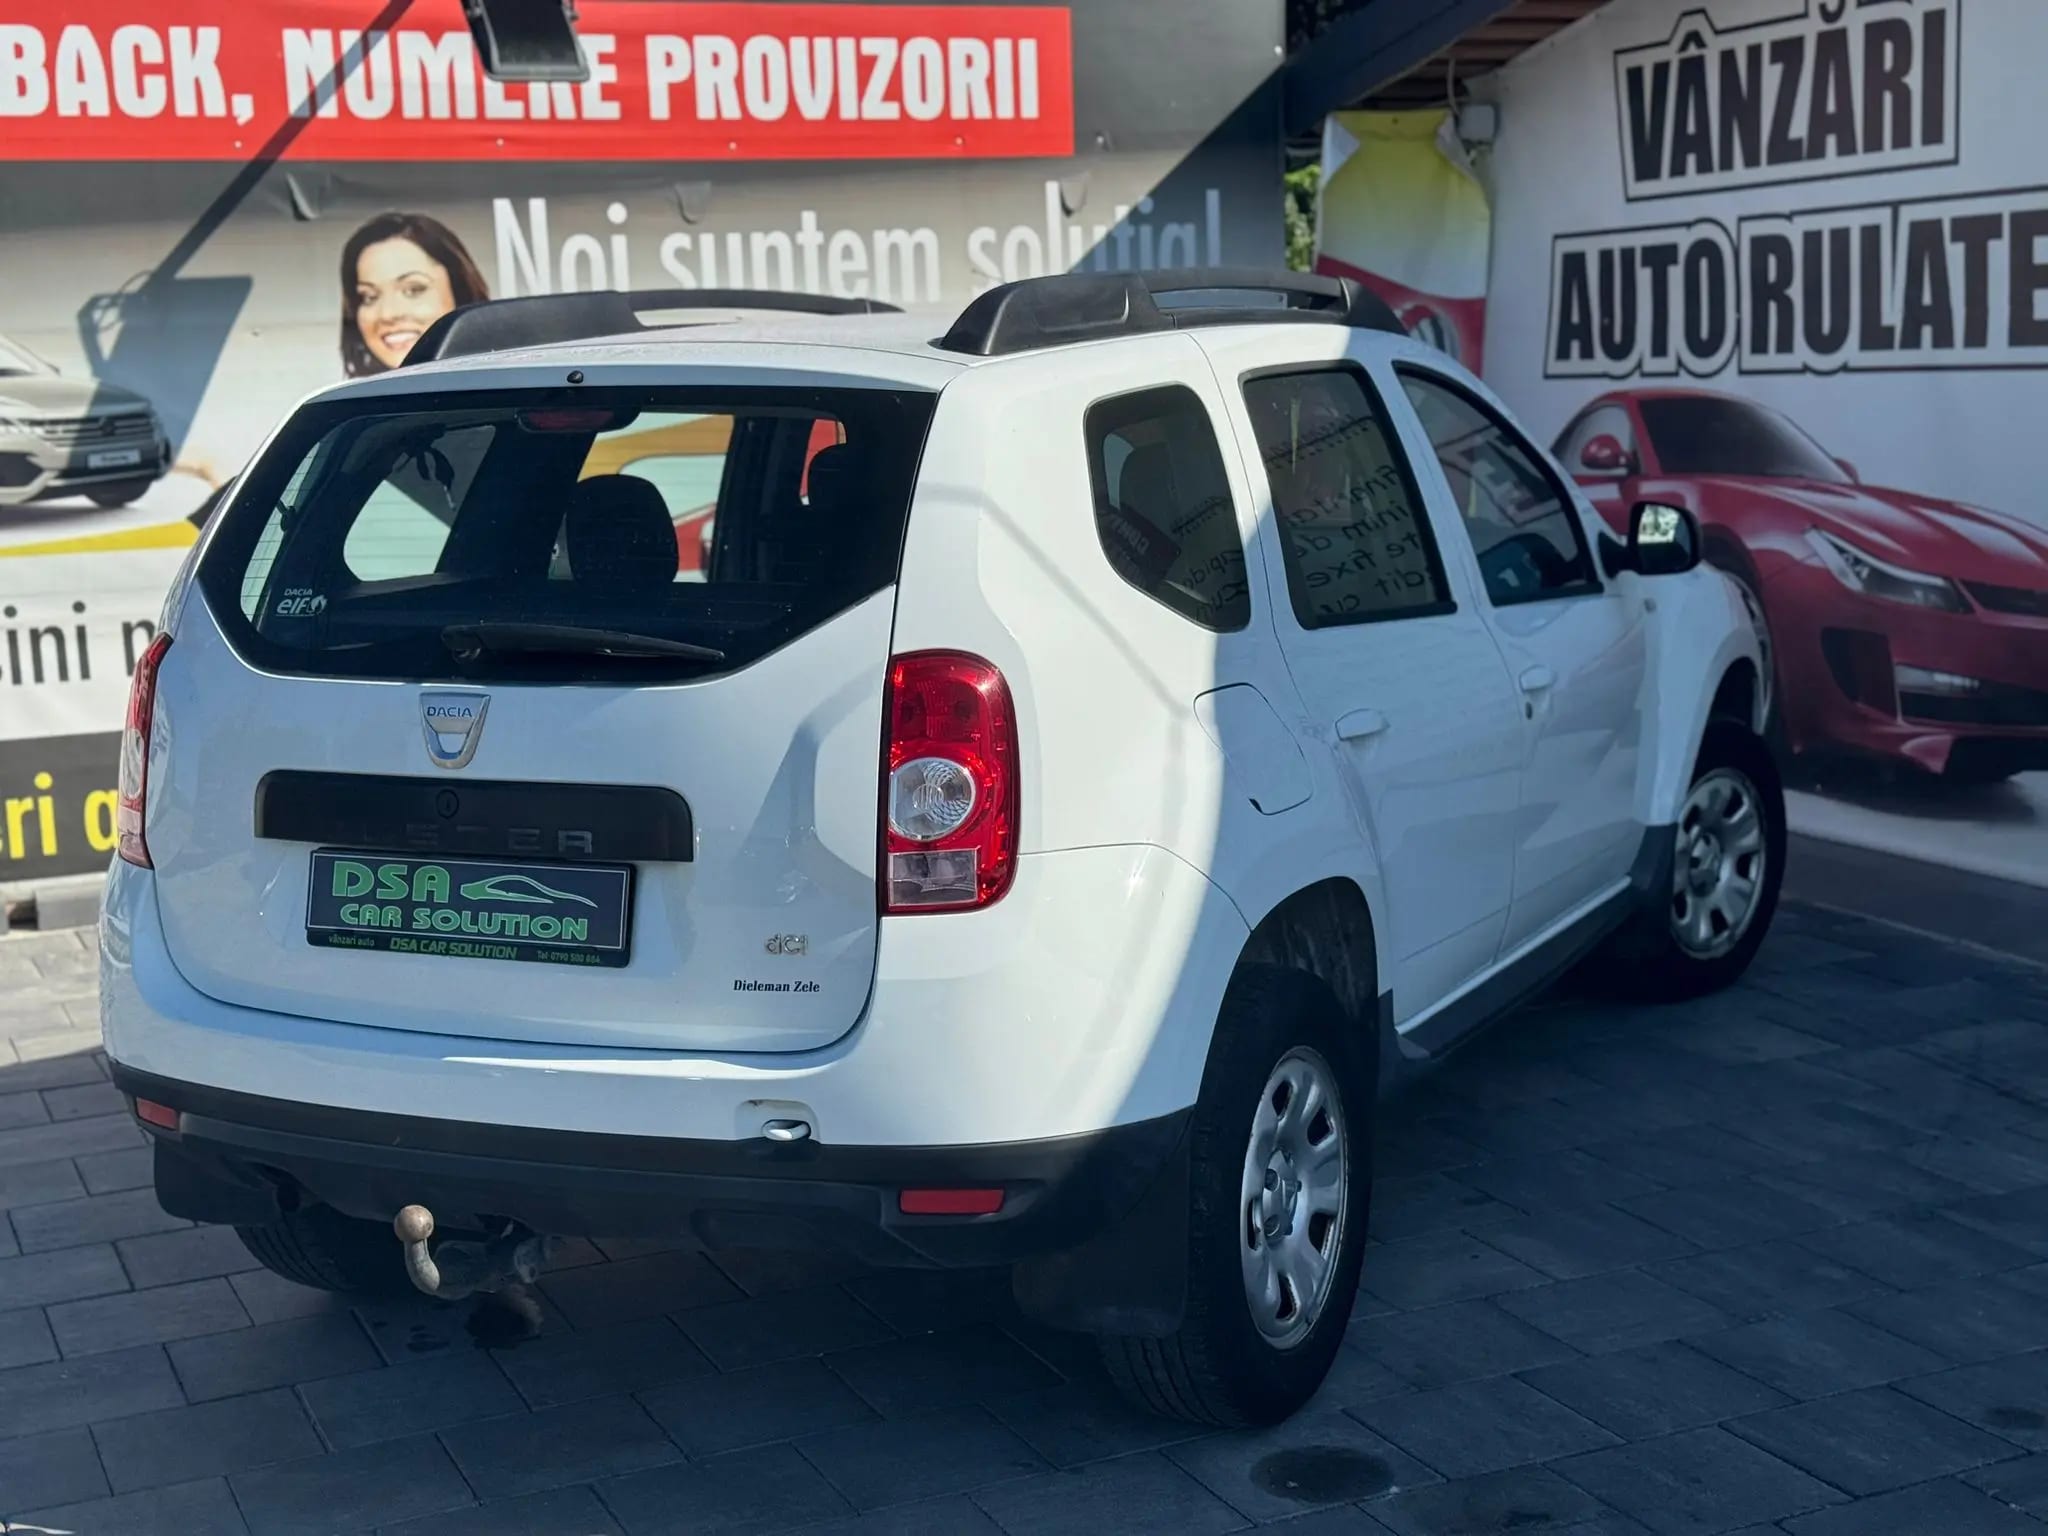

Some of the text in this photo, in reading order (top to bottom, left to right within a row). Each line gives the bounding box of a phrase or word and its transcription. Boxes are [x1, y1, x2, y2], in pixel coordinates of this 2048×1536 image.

[0, 24, 254, 125] BACK,
[645, 35, 1040, 121] PROVIZORII
[1625, 0, 1947, 183] VÂNZĂRI
[493, 198, 630, 300] Noi
[660, 210, 940, 302] suntem
[1555, 209, 2048, 362] AUTO RULATE
[276, 597, 311, 614] elf
[284, 588, 313, 596] DACIA
[0, 601, 91, 685] ini
[426, 706, 473, 718] DACIA
[0, 771, 58, 859] ri
[332, 860, 451, 903] DSA
[340, 903, 588, 941] CAR SOLUTION
[390, 937, 418, 951] DSA
[420, 940, 447, 954] CAR
[448, 942, 518, 960] SOLUTION
[733, 979, 821, 992] Dieleman Zele
